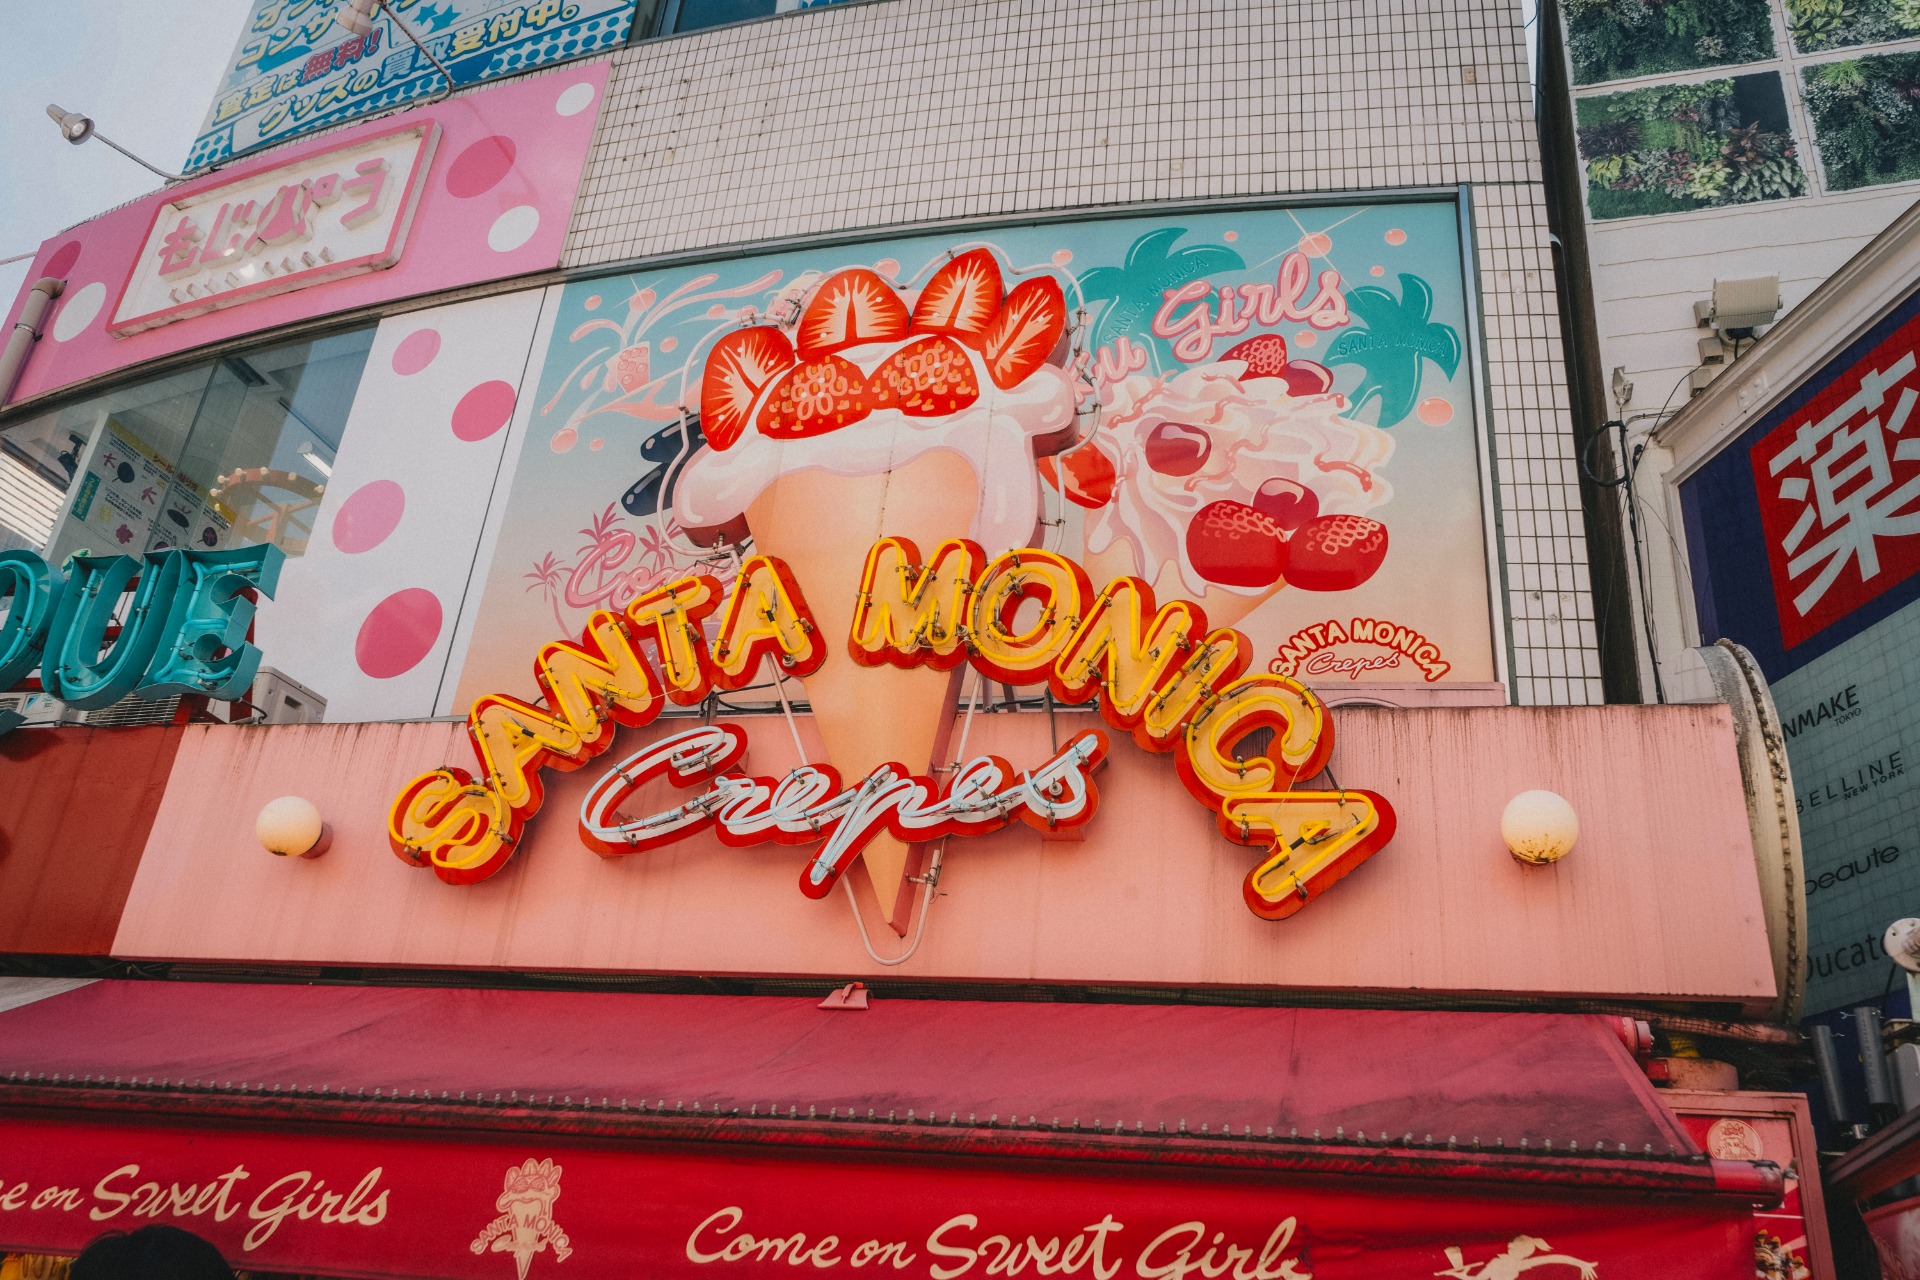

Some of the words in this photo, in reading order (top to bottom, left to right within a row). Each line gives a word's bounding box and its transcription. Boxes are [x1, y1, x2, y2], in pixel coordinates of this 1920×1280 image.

[1151, 252, 1351, 363] Girls
[1338, 333, 1388, 356] SANTA
[1768, 350, 1920, 617] 薬
[1268, 619, 1349, 677] SANTA
[1350, 617, 1451, 683] MONICA
[1306, 651, 1400, 680] Crepes
[389, 554, 829, 886] SANTA
[848, 536, 1397, 921] MONICA
[1834, 708, 1862, 727] TOKYO
[578, 722, 1110, 900] Crepes
[1844, 784, 1869, 801] NEW
[1872, 768, 1905, 788] YORK
[1805, 932, 1889, 983] ucat
[30, 1185, 85, 1212] on
[89, 1163, 250, 1222] Sweet
[243, 1166, 389, 1251] Girls
[469, 1214, 520, 1255] SANTA
[522, 1214, 573, 1263] MONICA
[685, 1206, 842, 1264] Come
[850, 1237, 917, 1268] on
[926, 1213, 1124, 1280] Sweet
